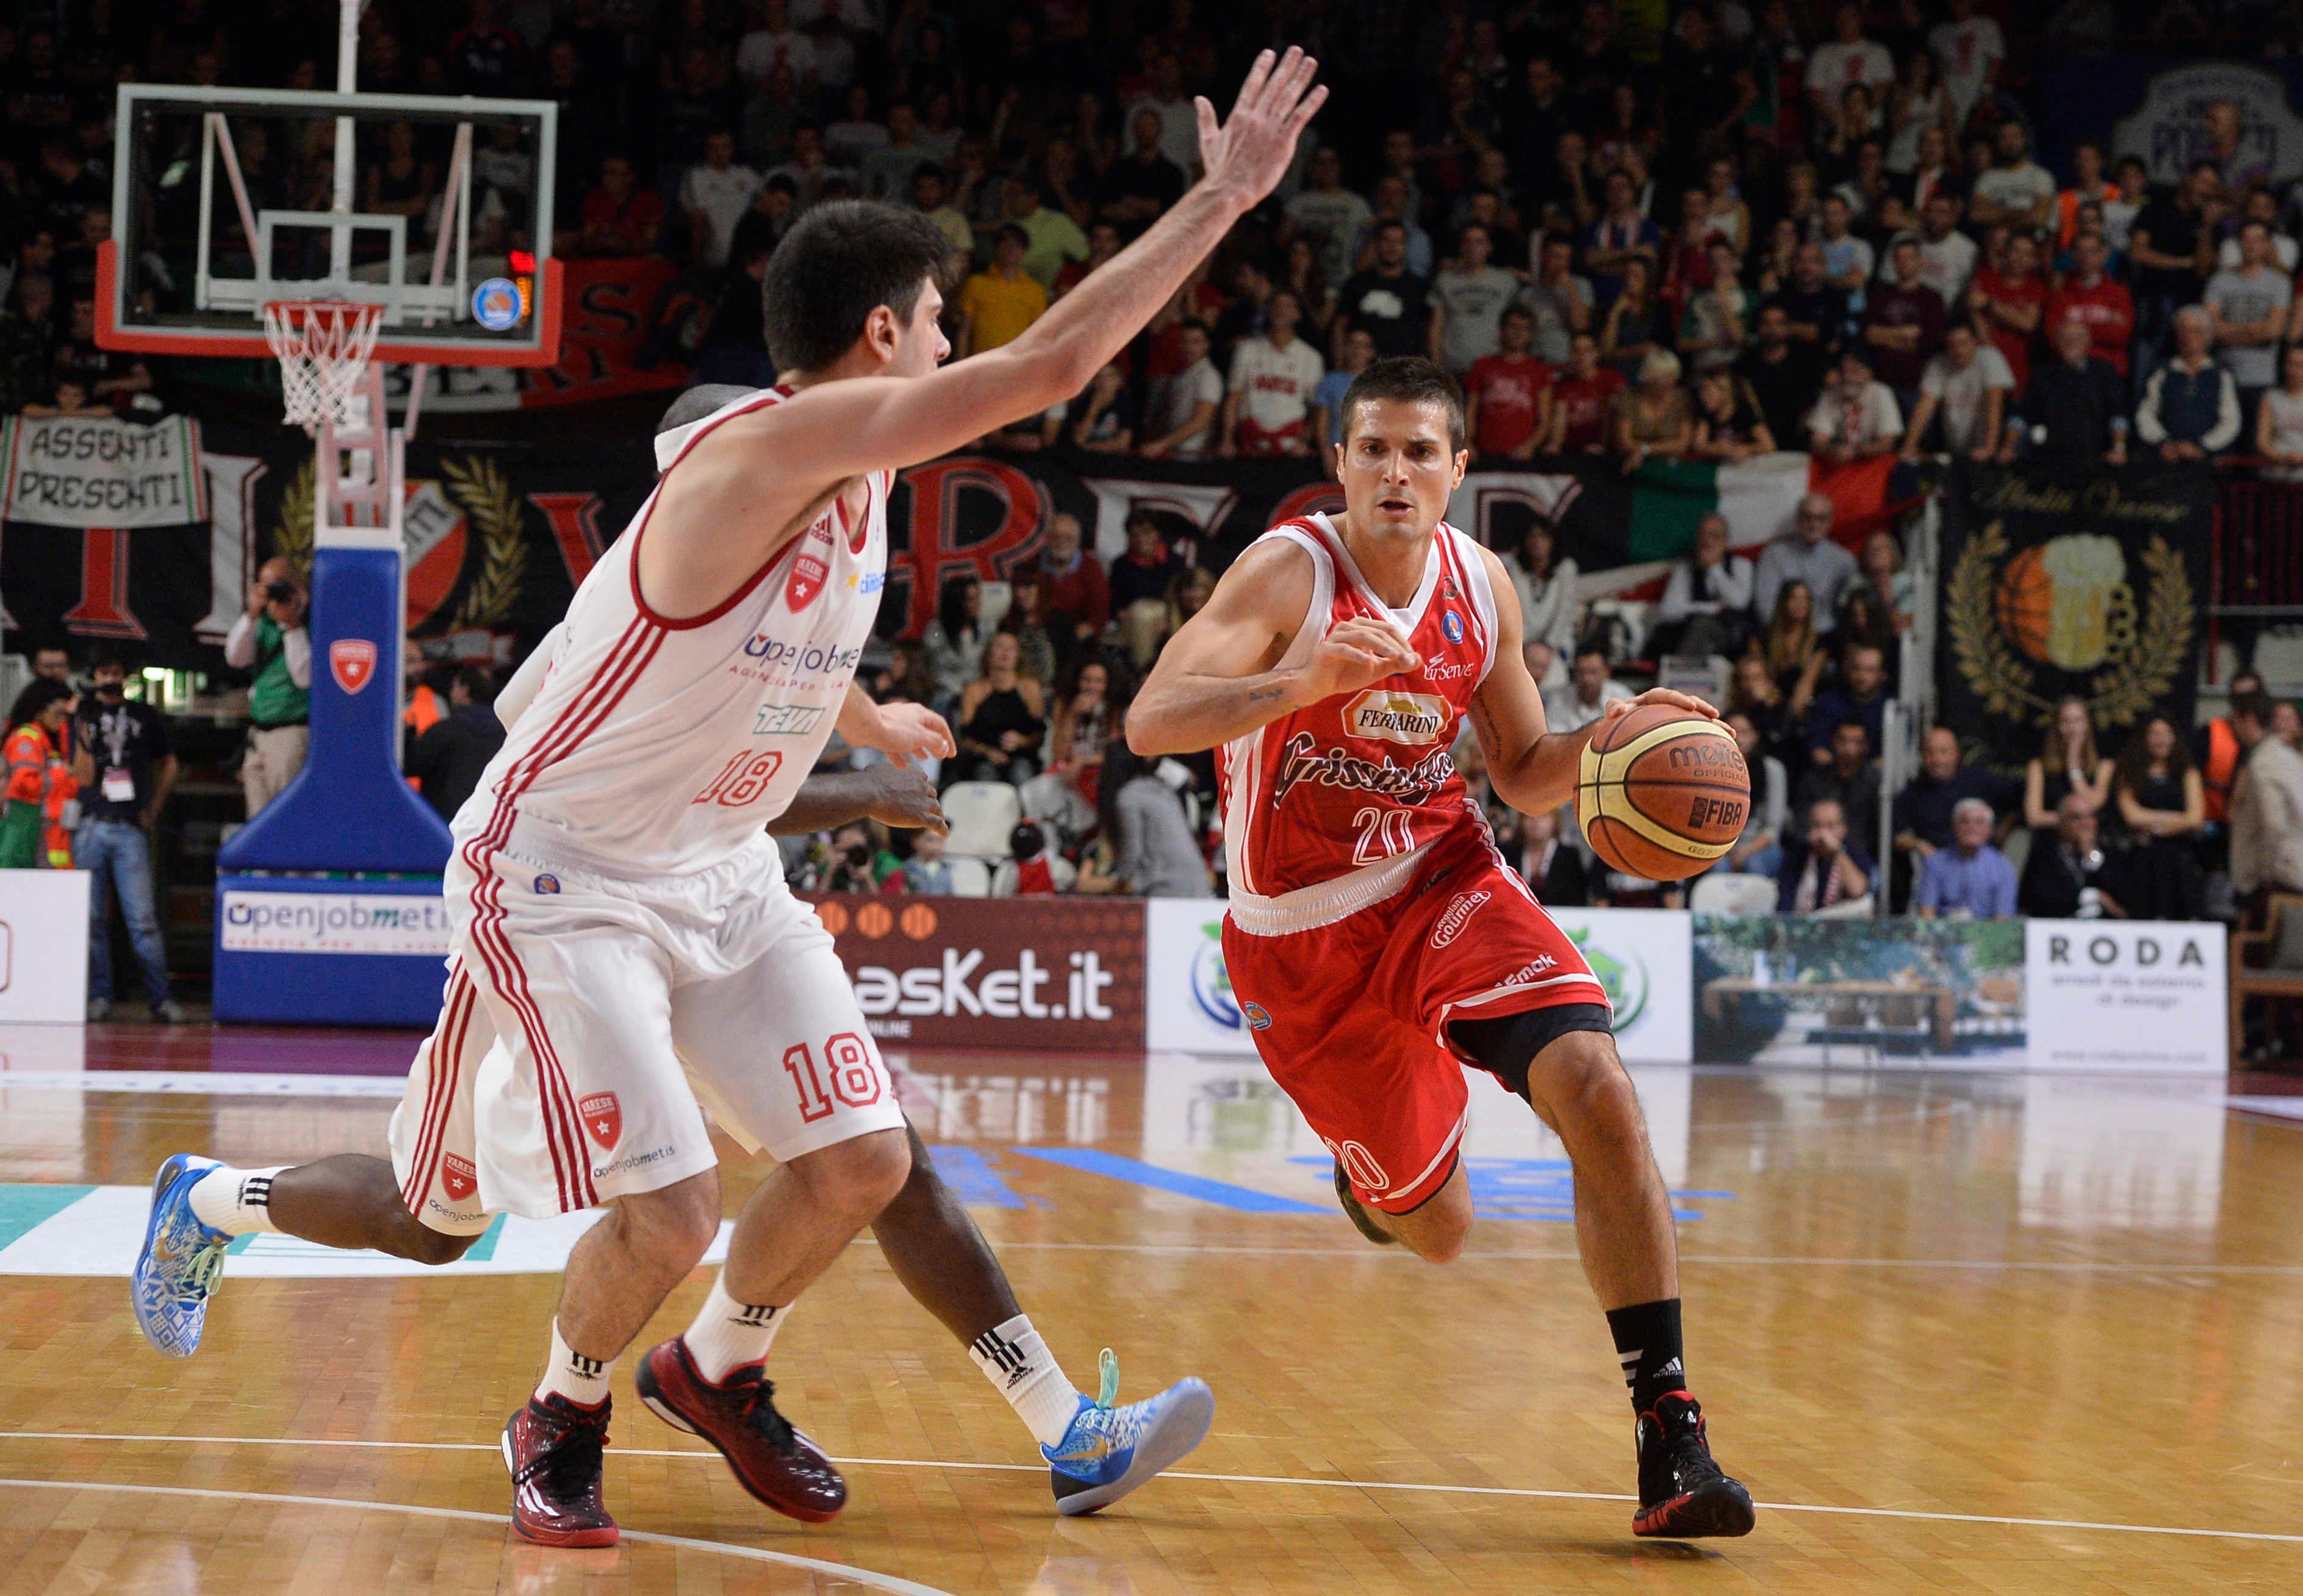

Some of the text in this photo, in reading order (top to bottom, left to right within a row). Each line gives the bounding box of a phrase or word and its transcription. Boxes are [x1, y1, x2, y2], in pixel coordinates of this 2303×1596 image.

[31, 427, 169, 461] ASSENTI
[18, 470, 181, 509] PRESENTI
[753, 704, 826, 735] TEVA
[1358, 709, 1439, 735] FERRARINI
[691, 749, 782, 807] 18
[1705, 799, 1743, 826] FIBA
[1352, 807, 1415, 866] 20
[228, 896, 453, 937] Openjobmeti
[1434, 891, 1488, 946] Gourmet
[2049, 935, 2205, 966] RODA
[783, 1032, 881, 1123] 18
[447, 1155, 476, 1174] VARES
